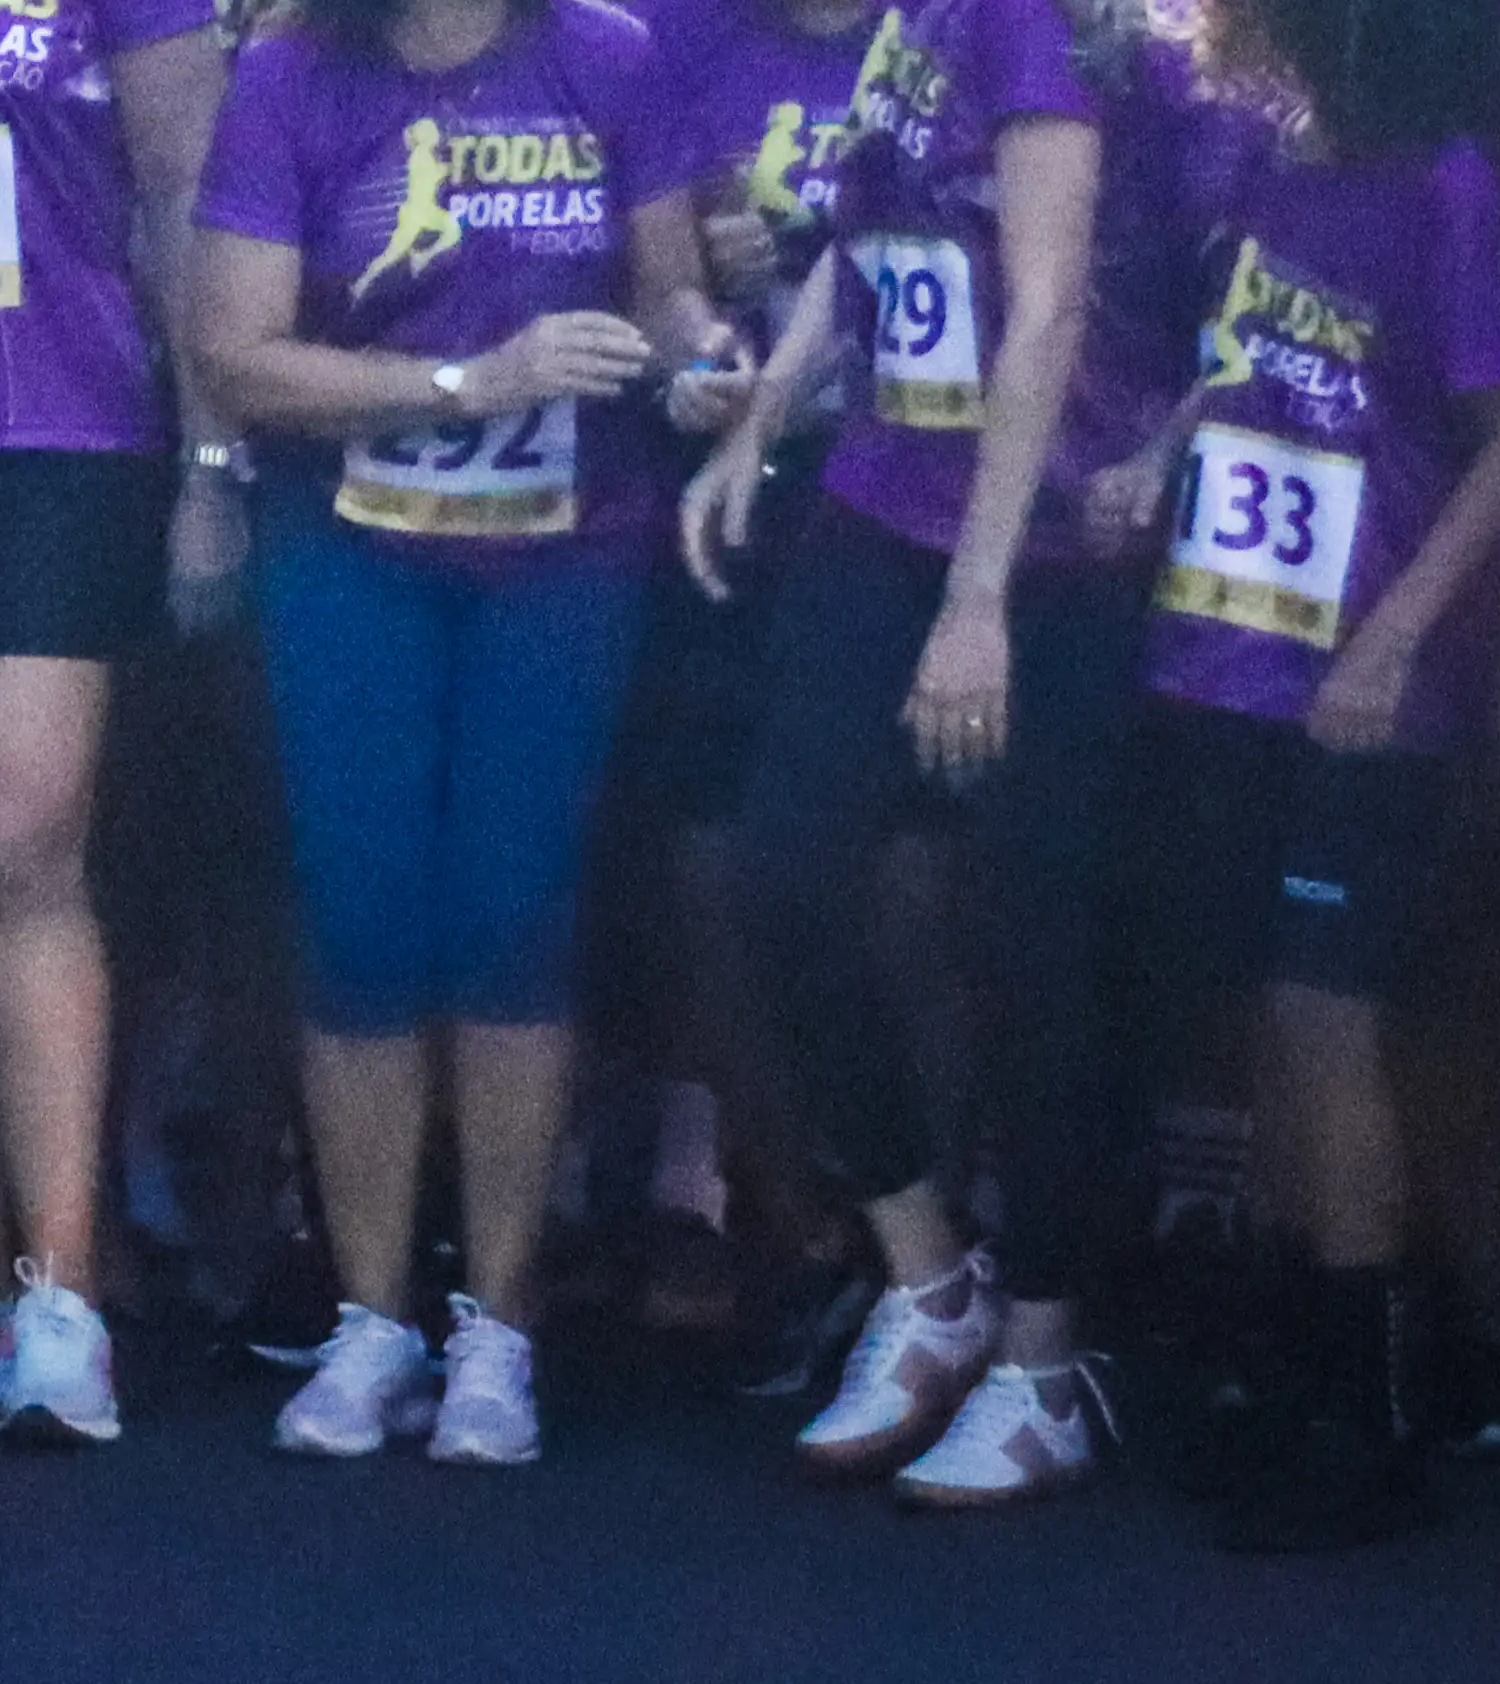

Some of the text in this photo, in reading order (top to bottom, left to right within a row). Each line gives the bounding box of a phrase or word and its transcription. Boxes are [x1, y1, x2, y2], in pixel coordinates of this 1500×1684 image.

[449, 134, 603, 185] TODAS
[448, 189, 604, 228] POR ELAS
